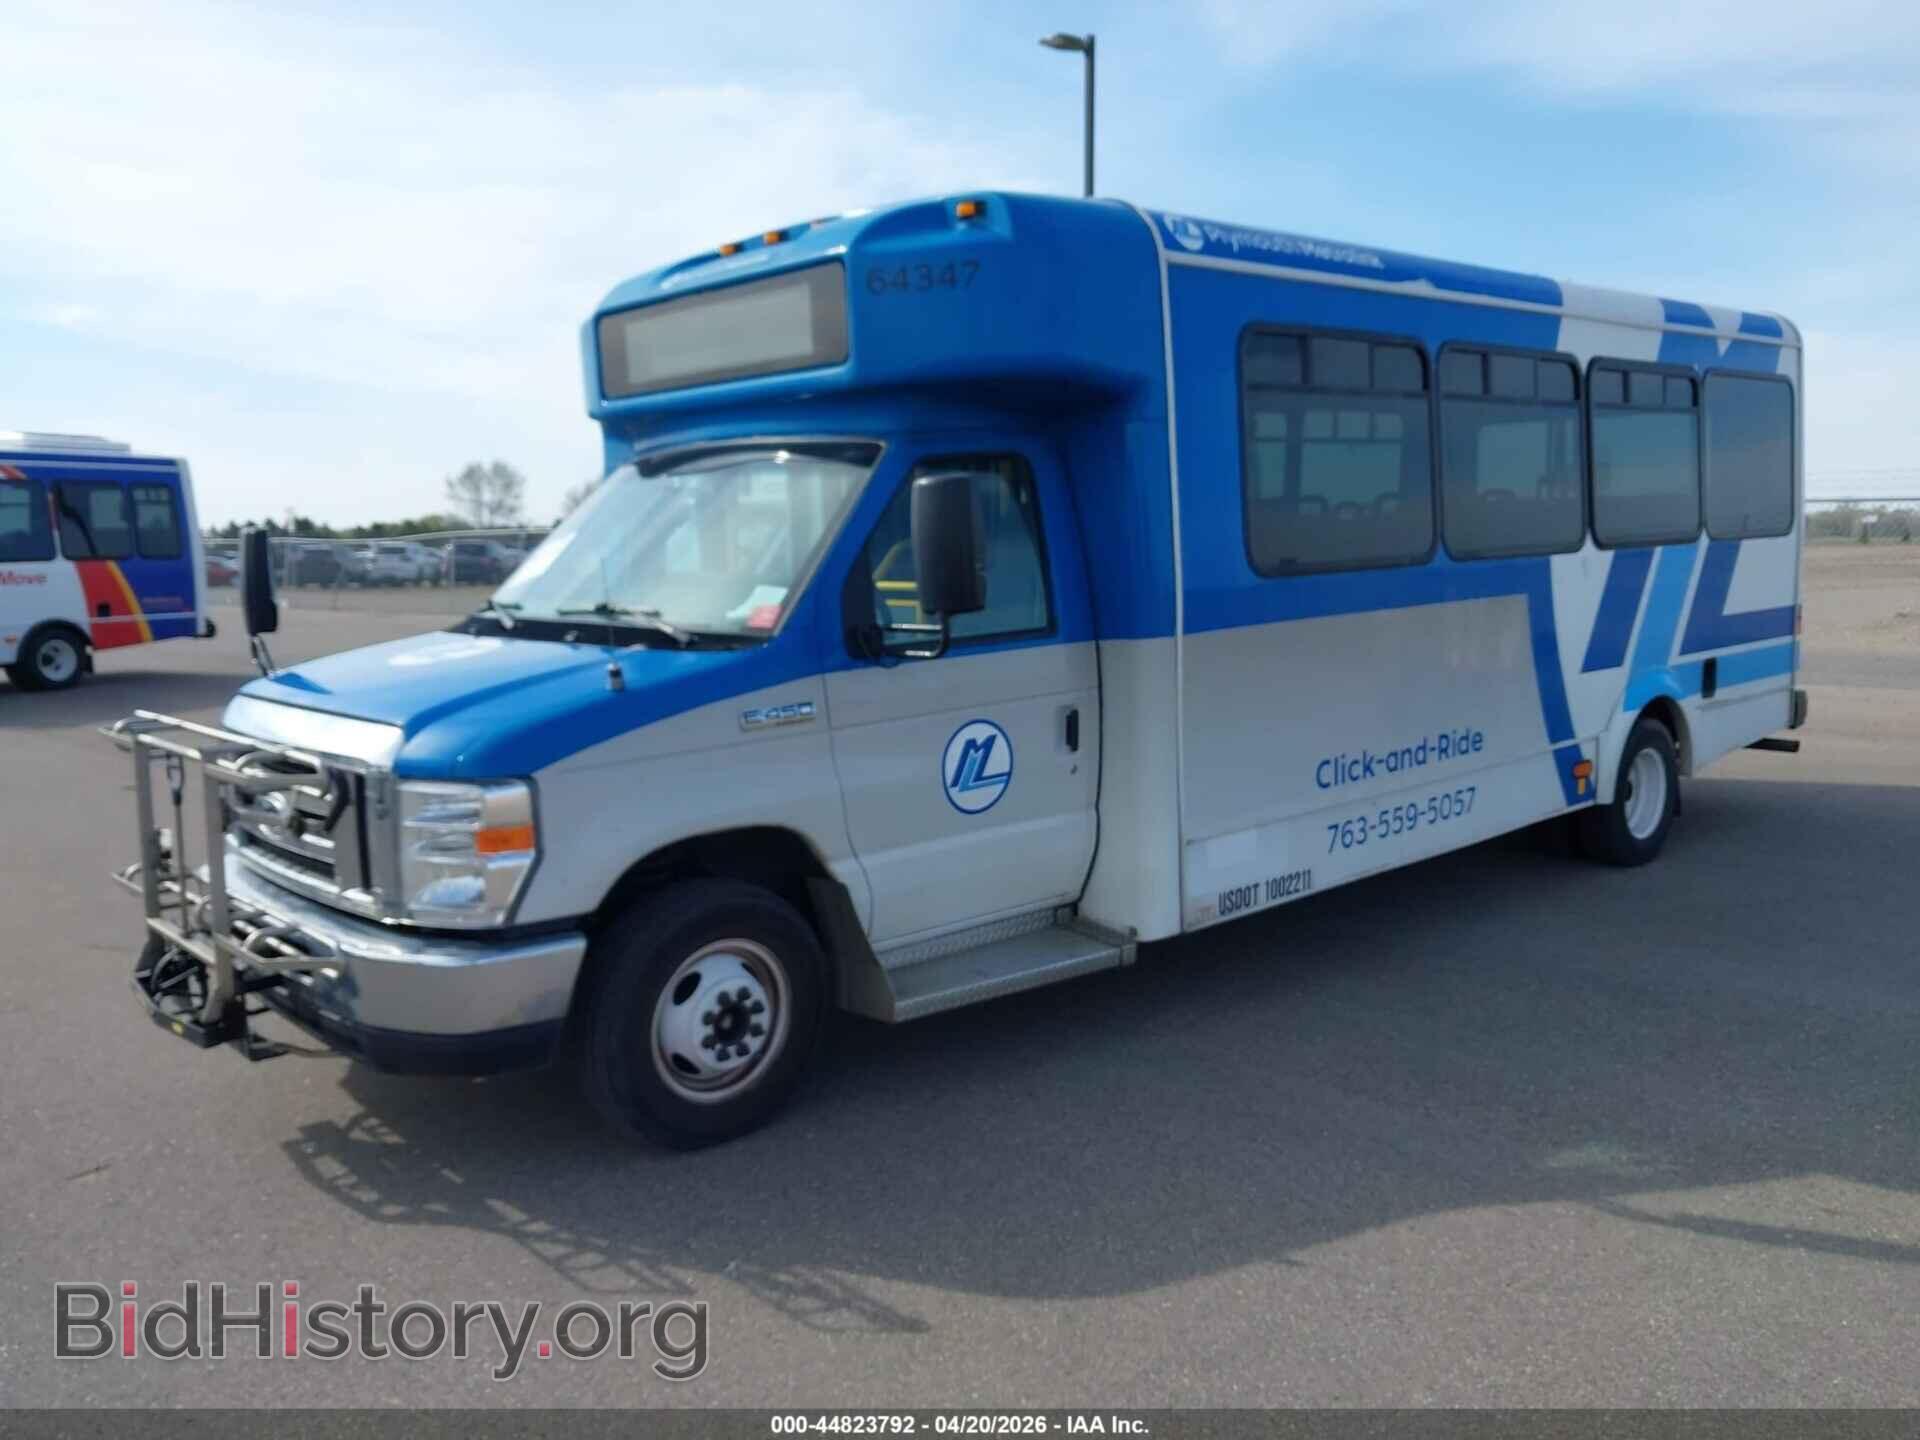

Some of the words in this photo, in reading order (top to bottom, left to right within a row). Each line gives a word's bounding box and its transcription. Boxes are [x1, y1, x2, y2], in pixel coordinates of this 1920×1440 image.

[866, 259, 980, 296] 64347
[1316, 728, 1484, 789] Click-and-Ride
[1326, 786, 1477, 854] 763-559-5057
[1218, 882, 1260, 916] USDOT
[1265, 869, 1312, 901] 1002211
